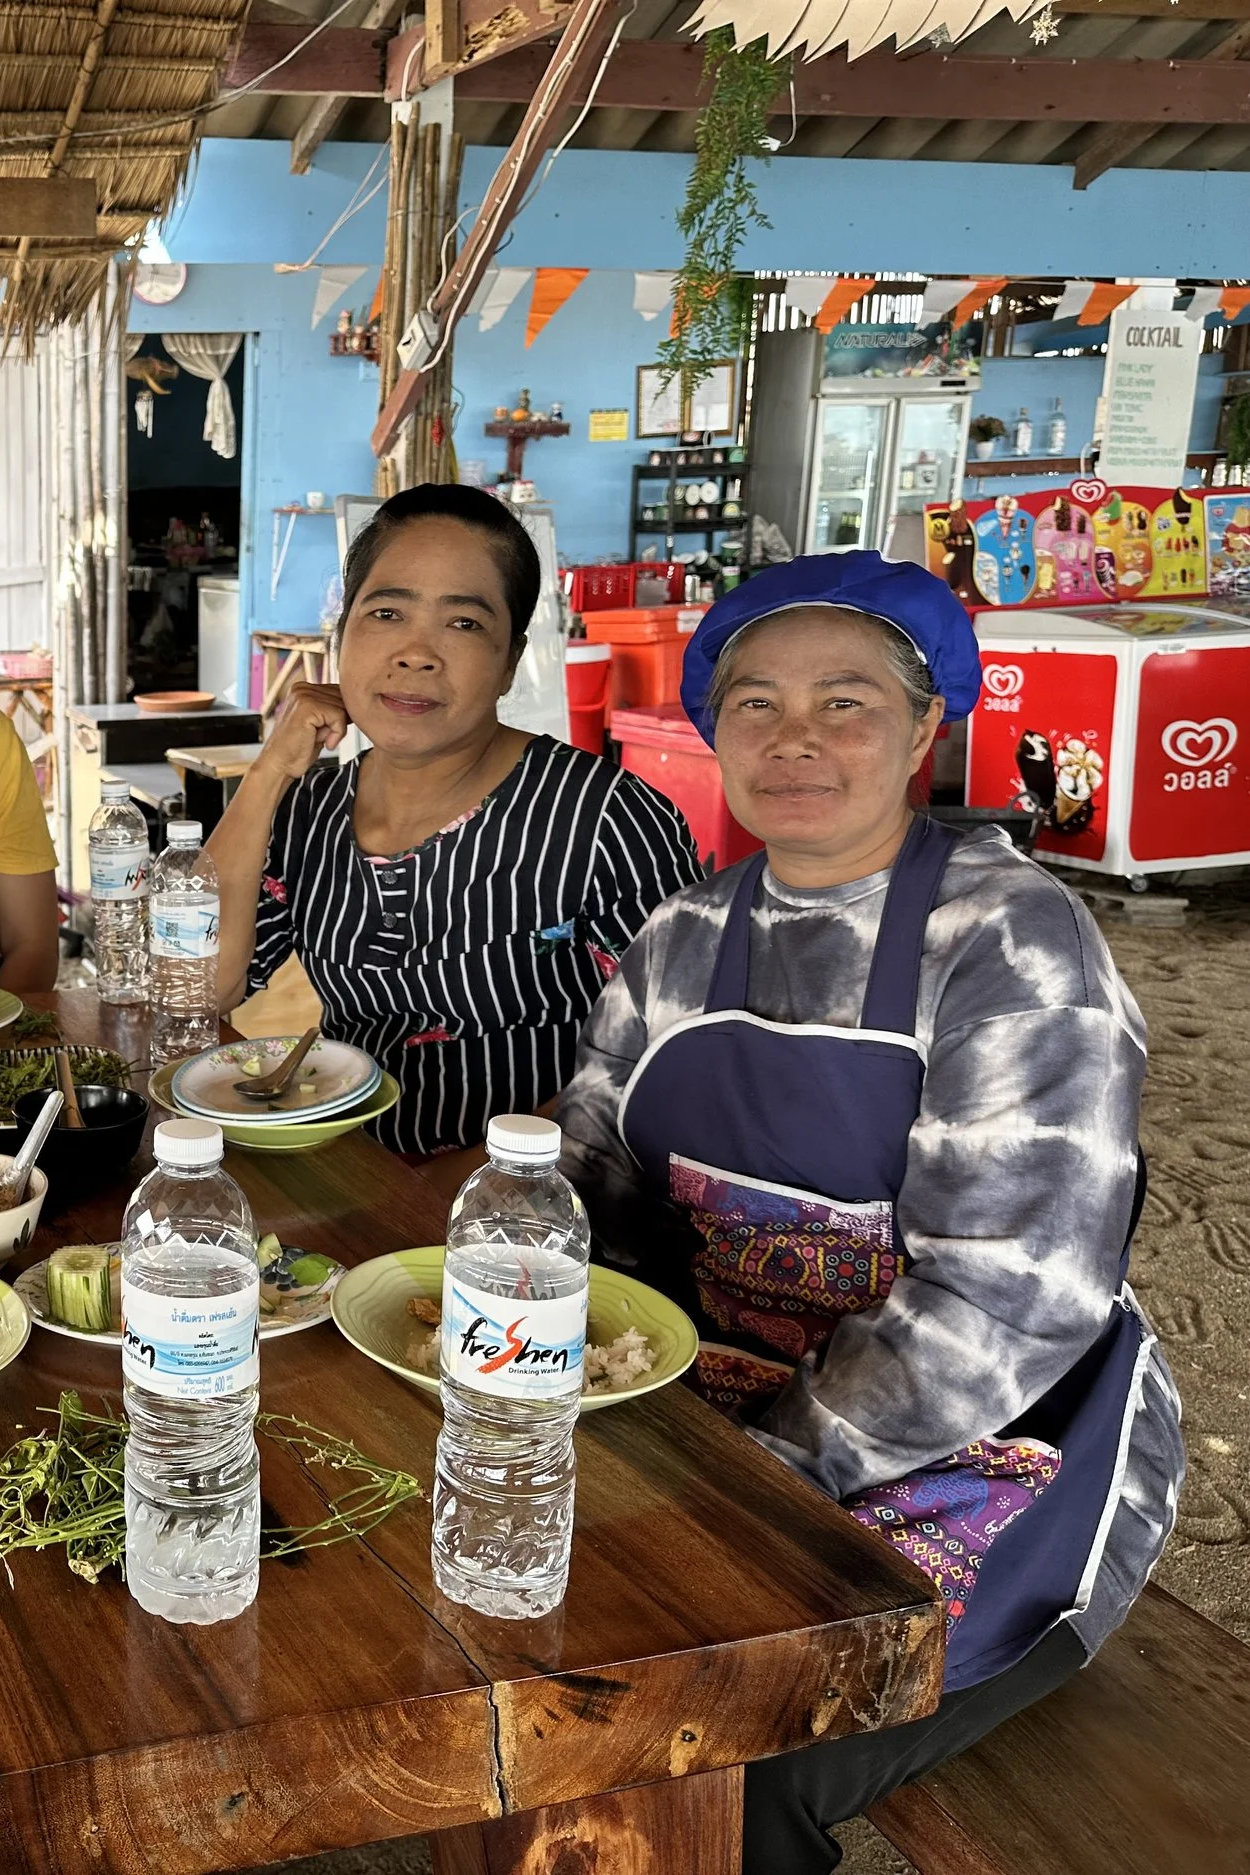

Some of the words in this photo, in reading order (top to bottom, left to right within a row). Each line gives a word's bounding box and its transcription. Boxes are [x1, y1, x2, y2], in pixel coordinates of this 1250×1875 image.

[1126, 326, 1183, 348] COCKTAIL
[1163, 763, 1233, 792] วอลล์
[508, 1367, 540, 1376] Drinking
[540, 1367, 560, 1375] Water
